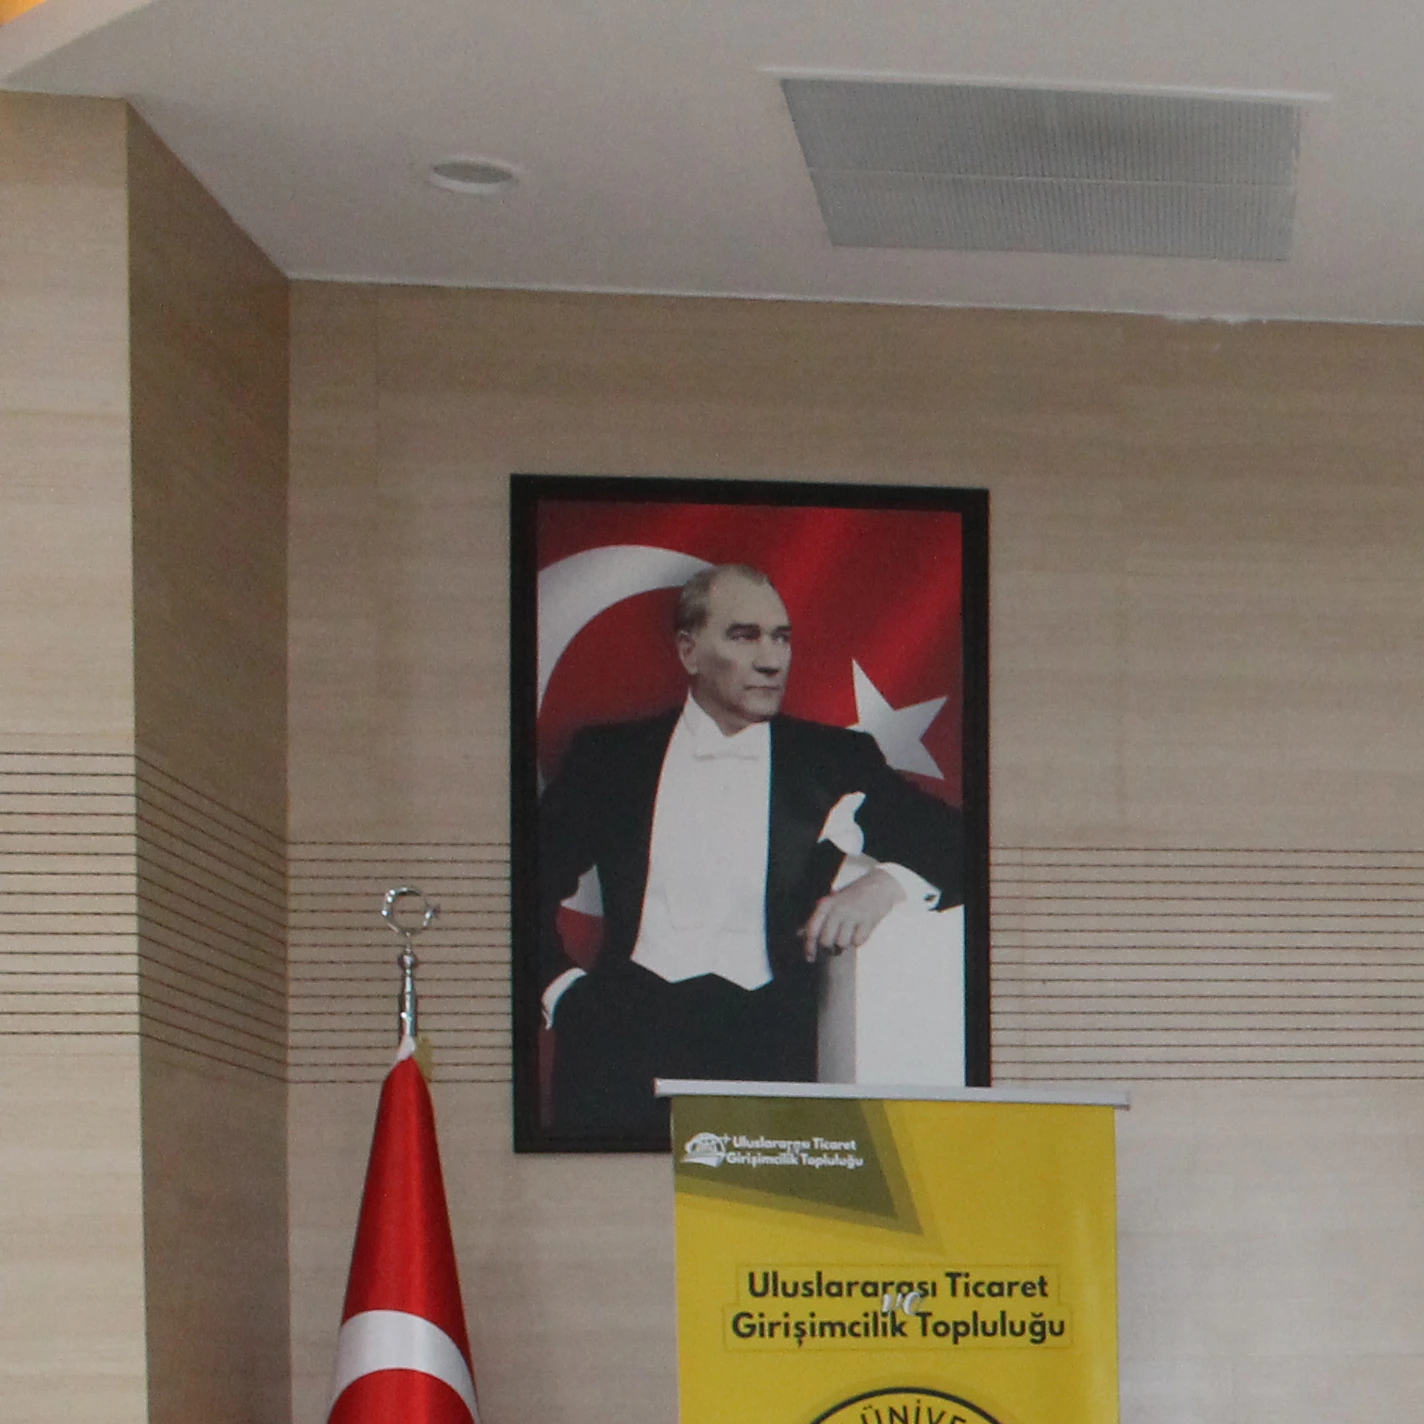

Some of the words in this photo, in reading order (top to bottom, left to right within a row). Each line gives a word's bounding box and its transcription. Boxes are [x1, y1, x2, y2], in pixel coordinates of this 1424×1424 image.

[813, 1137, 857, 1150] Ticaret
[802, 1153, 864, 1169] Topluluğu
[748, 1271, 937, 1298] Uluslararası
[945, 1271, 1048, 1298] Ticaret
[732, 1310, 907, 1348] Girişimcilik
[917, 1310, 1065, 1345] Topluluğu
